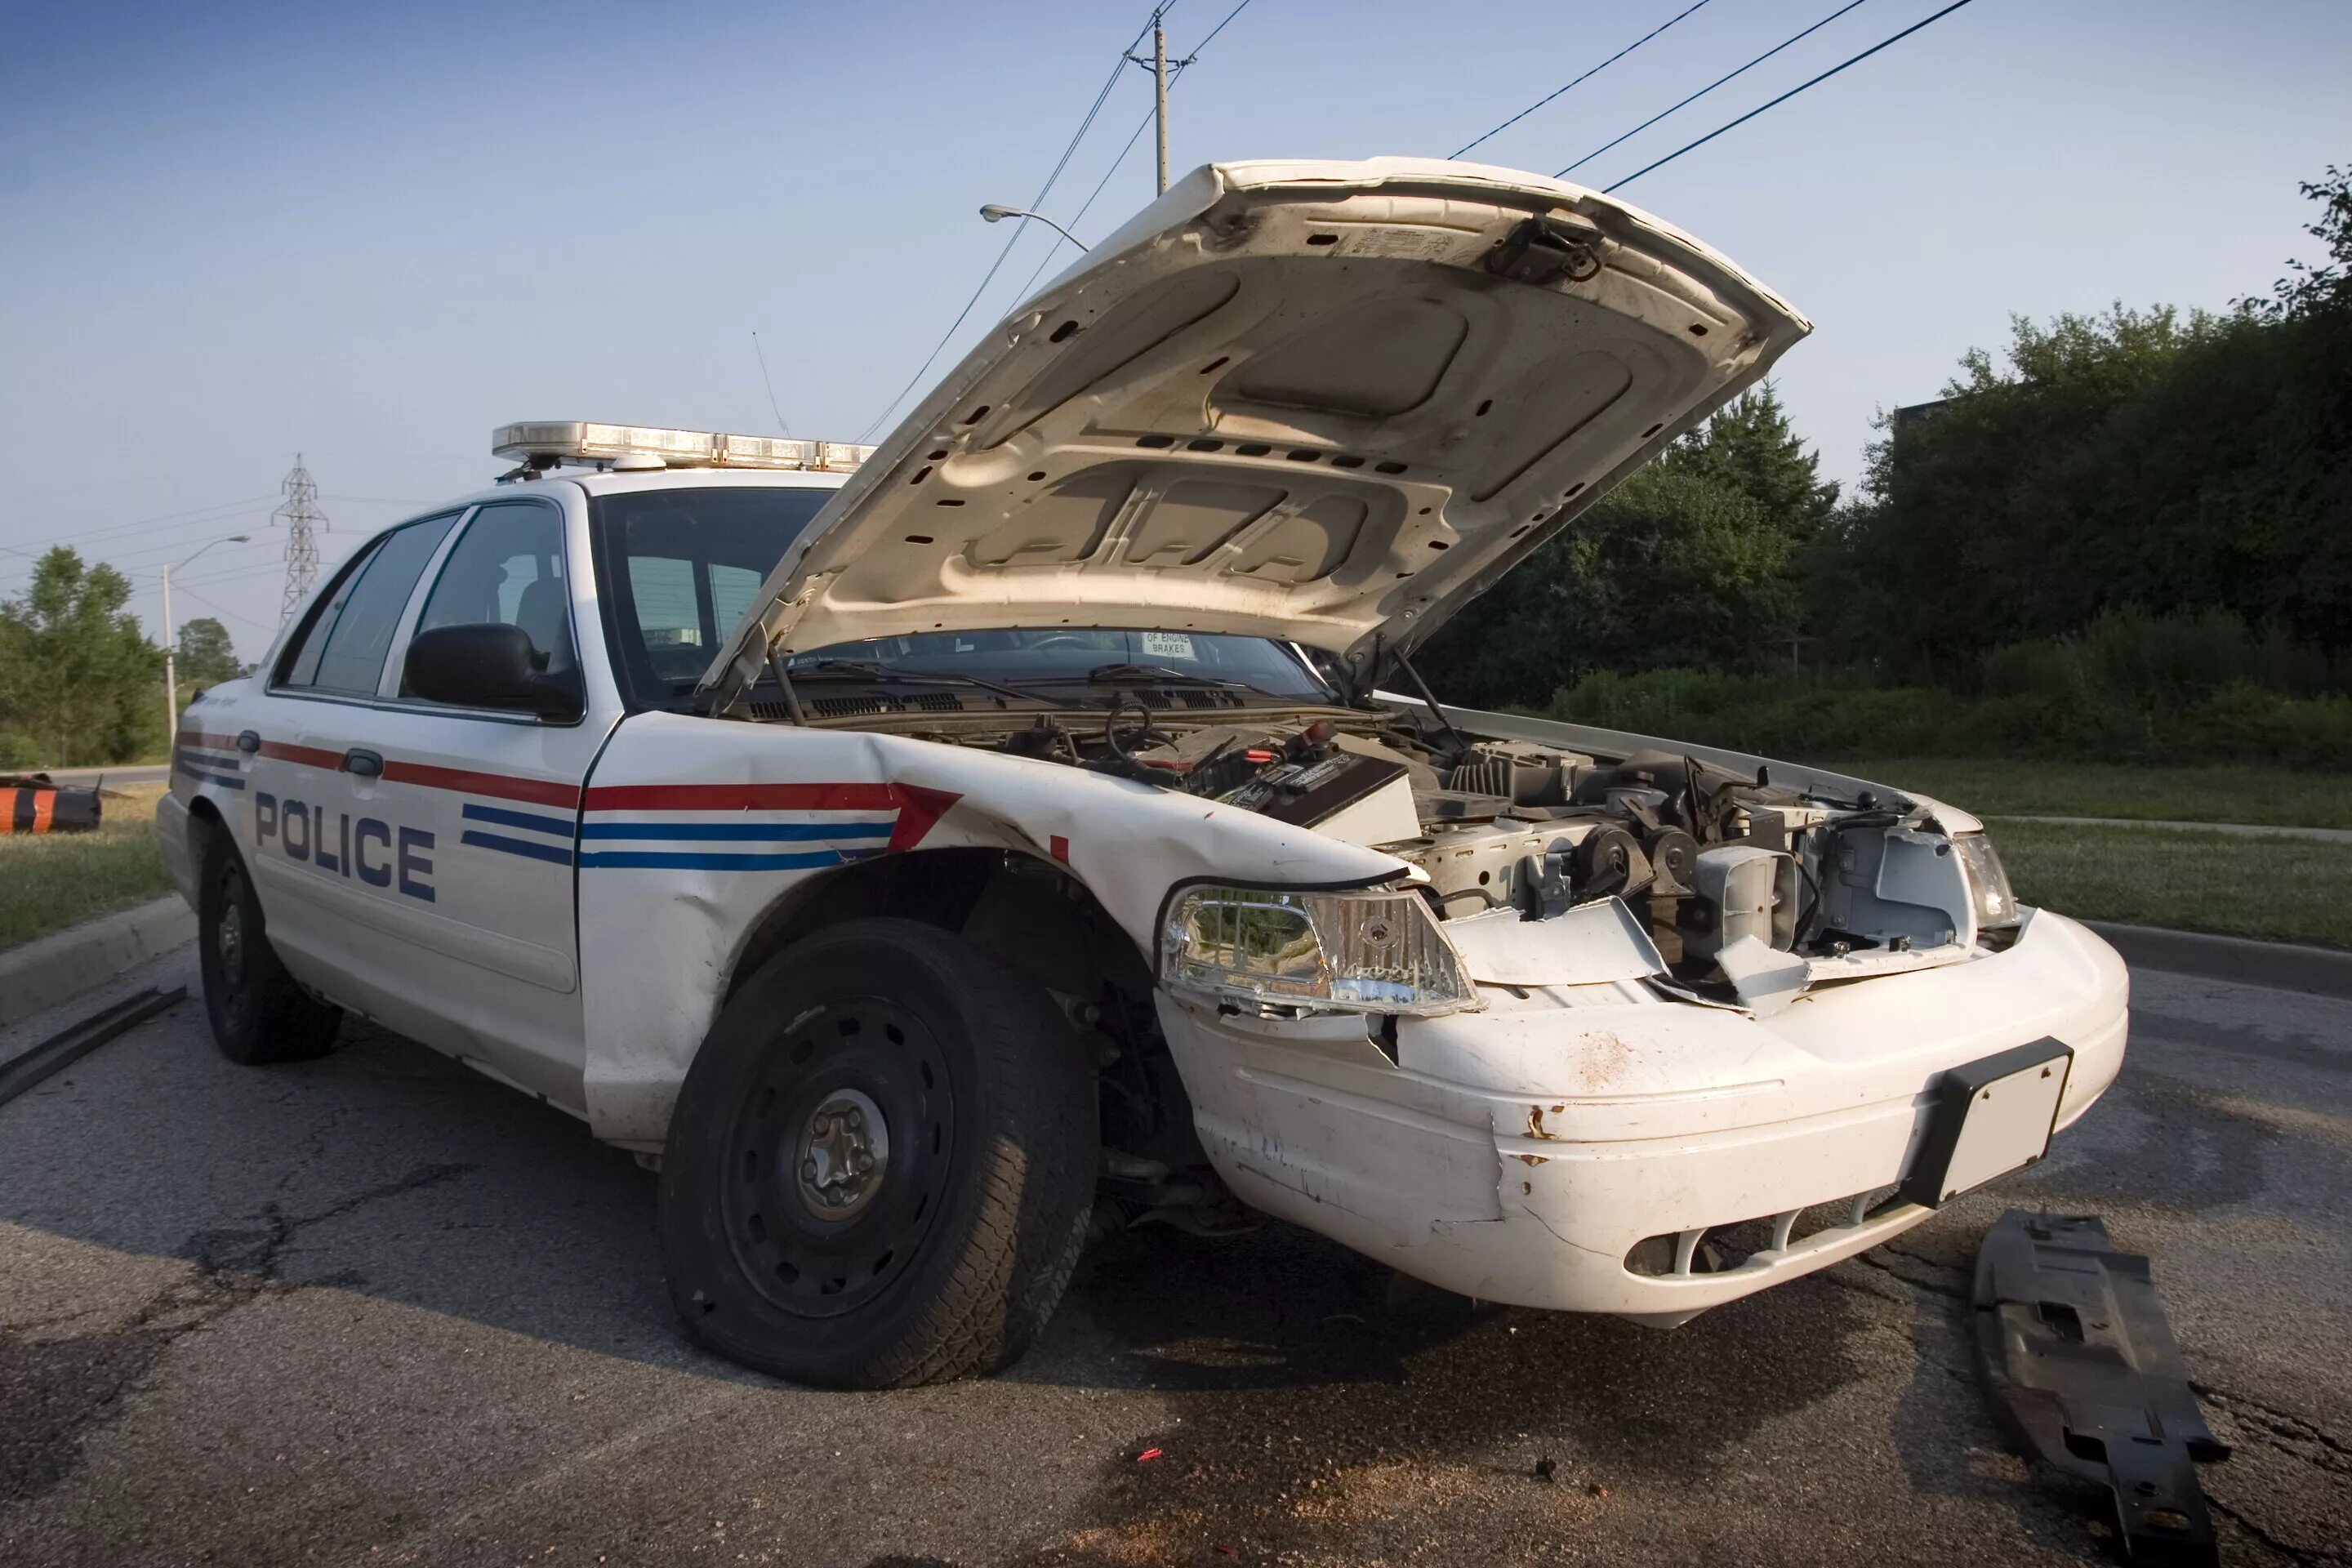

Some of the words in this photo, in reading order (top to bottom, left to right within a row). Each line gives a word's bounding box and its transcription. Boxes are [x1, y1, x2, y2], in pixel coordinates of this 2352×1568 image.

[1147, 633, 1158, 642] OF
[1162, 633, 1189, 643] ENGINE
[1153, 644, 1185, 653] BRAKES
[256, 791, 435, 903] POLICE
